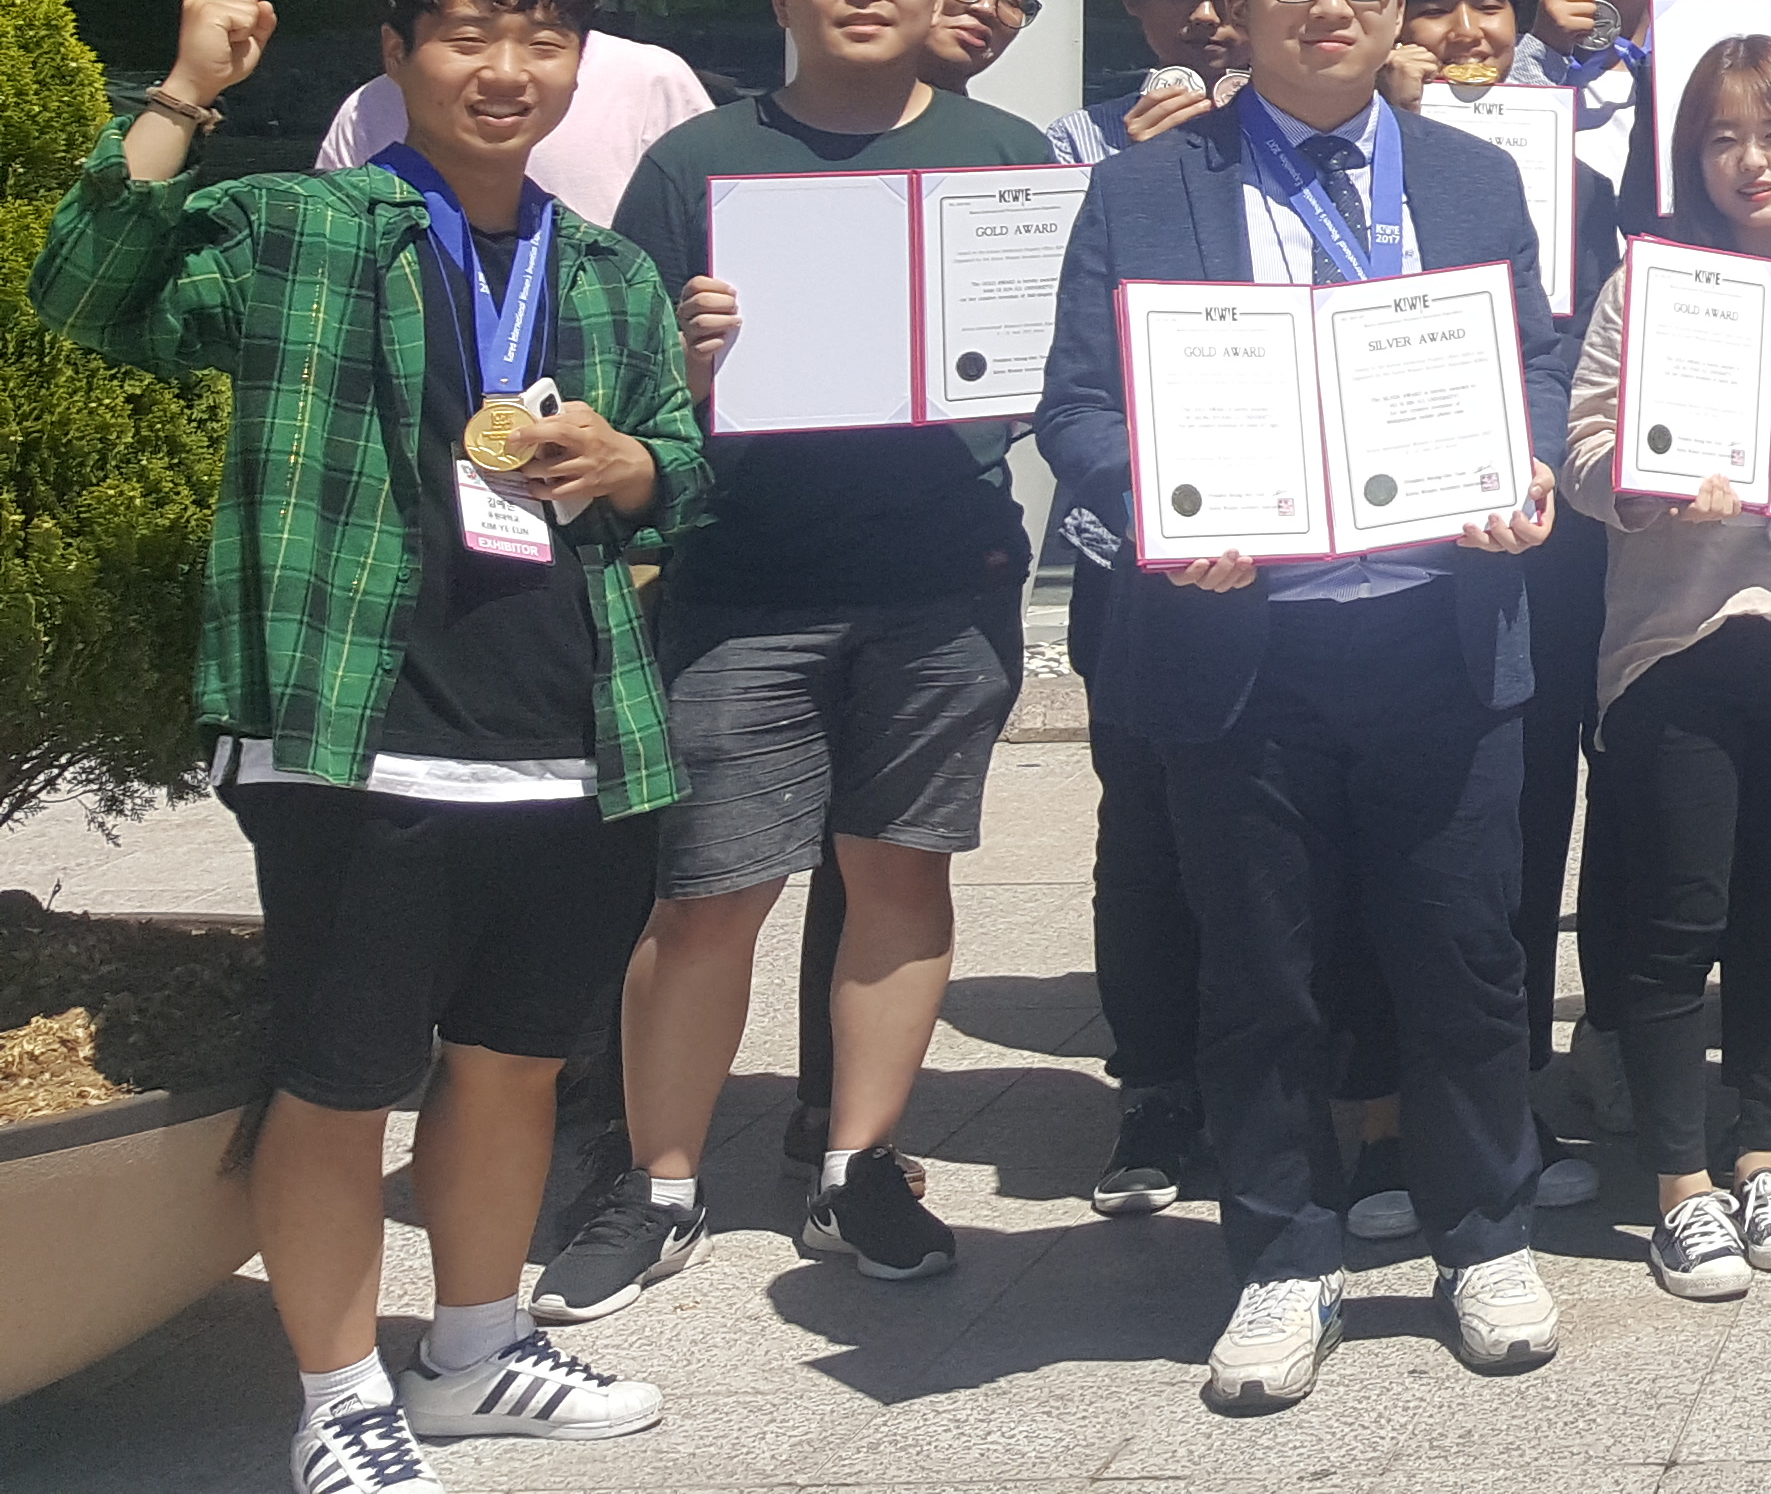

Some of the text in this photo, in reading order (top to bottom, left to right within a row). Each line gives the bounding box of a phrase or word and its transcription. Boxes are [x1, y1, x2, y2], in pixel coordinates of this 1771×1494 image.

[976, 223, 1058, 237] GOLD AWARD
[1375, 234, 1400, 244] 2017
[1674, 302, 1739, 321] GOLD AWARD
[1368, 328, 1466, 352] SILVER AWARD
[1184, 346, 1266, 358] GOLD AWARD
[478, 537, 539, 556] EXHIBITOR
